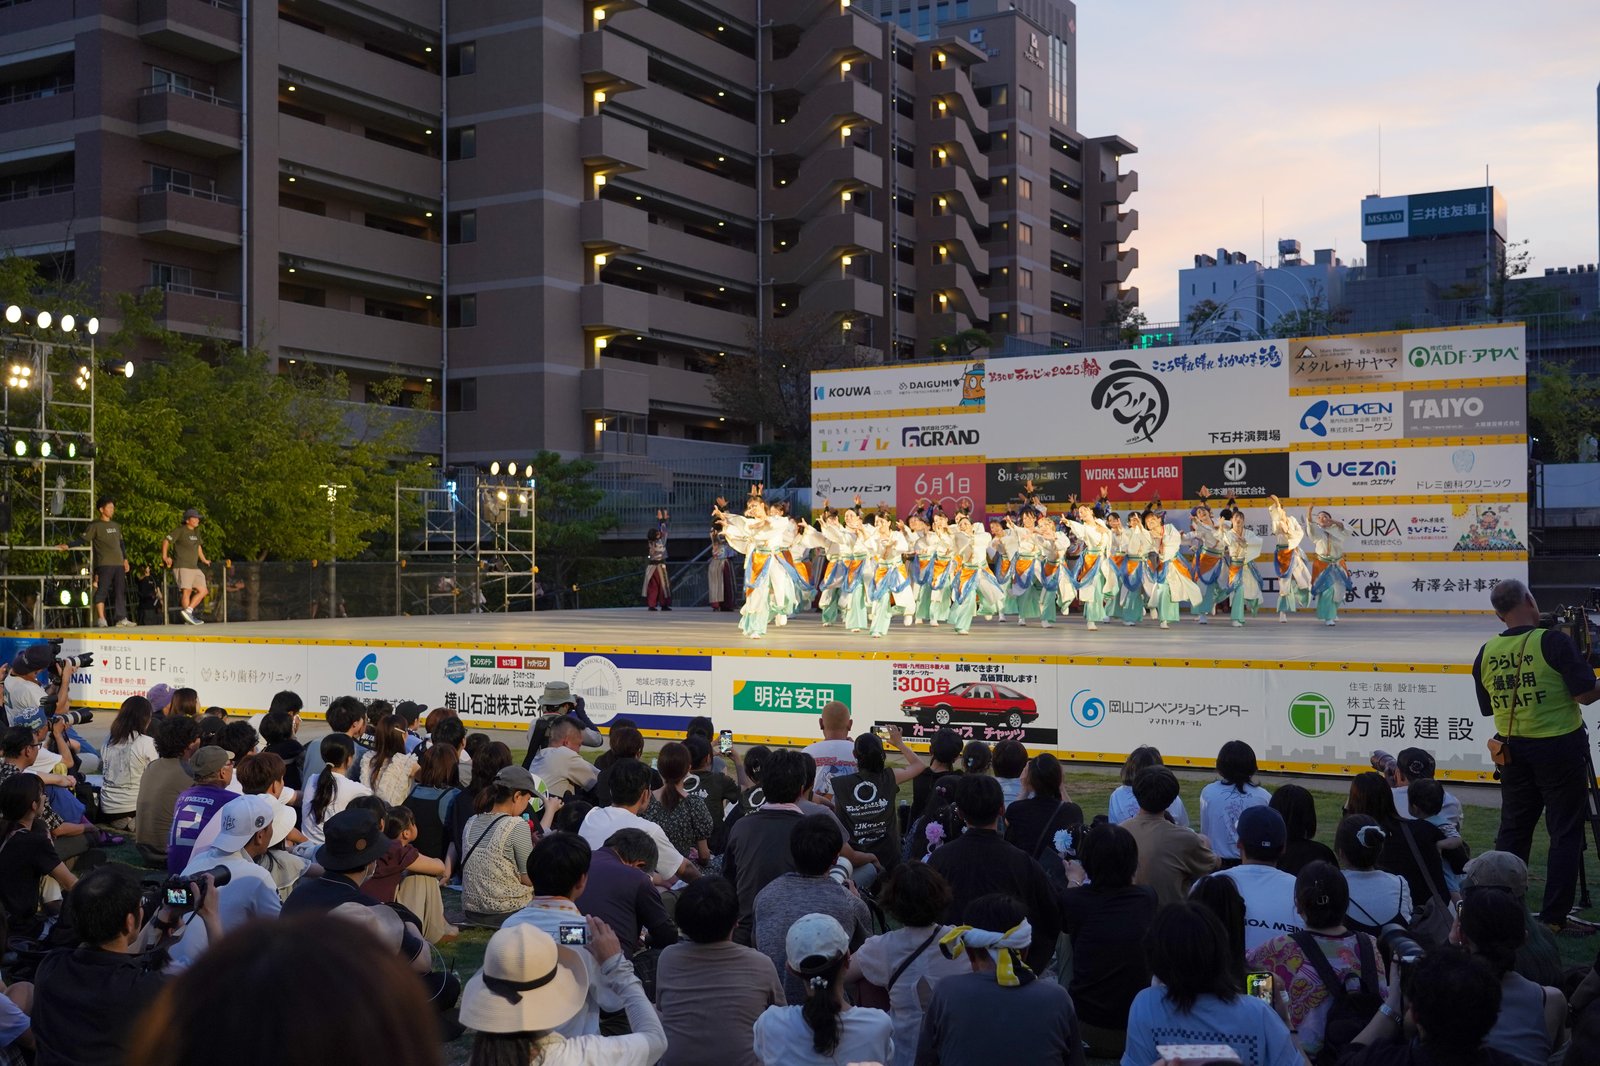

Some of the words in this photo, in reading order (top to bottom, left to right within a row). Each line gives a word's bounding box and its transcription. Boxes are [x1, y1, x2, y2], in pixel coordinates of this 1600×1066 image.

[1367, 213, 1402, 223] MS&AD
[1412, 202, 1490, 221] 三井住友海上
[1295, 357, 1398, 374] メタル・ササヤマ
[829, 386, 871, 397] KOUWA
[909, 380, 953, 390] DAIGUMI
[1330, 402, 1392, 416] KOKEN
[1409, 397, 1484, 419] TAIYO
[1355, 422, 1393, 432] コーケン
[920, 429, 980, 447] GRAND
[1208, 429, 1281, 444] 下石井演舞場
[1085, 468, 1116, 480] WORK
[1118, 467, 1149, 479] SMILE
[1151, 466, 1178, 478] LABO
[914, 472, 970, 495] 6月1日
[1416, 479, 1511, 489] ドレミ歯科クリニック
[115, 656, 166, 671] BELIEF
[169, 664, 188, 674] inc.
[1489, 653, 1533, 671] うらじゃ
[69, 674, 92, 684] NAN
[215, 669, 301, 683] きらり歯科クリニック
[636, 677, 696, 687] 地域と呼吸する大学
[1493, 672, 1536, 690] 撮影用
[356, 682, 378, 692] MEC
[898, 677, 950, 693] 300台
[1349, 682, 1393, 692] 住宅・店舗
[1398, 683, 1437, 693] 設計施工
[627, 690, 707, 708] 岡山商科大学
[755, 686, 834, 709] 明治安田
[1347, 697, 1406, 710] 株式会社
[1492, 690, 1546, 708] STAFF
[1109, 700, 1249, 717] 岡山コンベンションセンター
[1347, 714, 1474, 741] 万誠建設
[184, 797, 215, 806] mazda
[1244, 919, 1270, 929] YO
[1272, 922, 1303, 933] NEW
